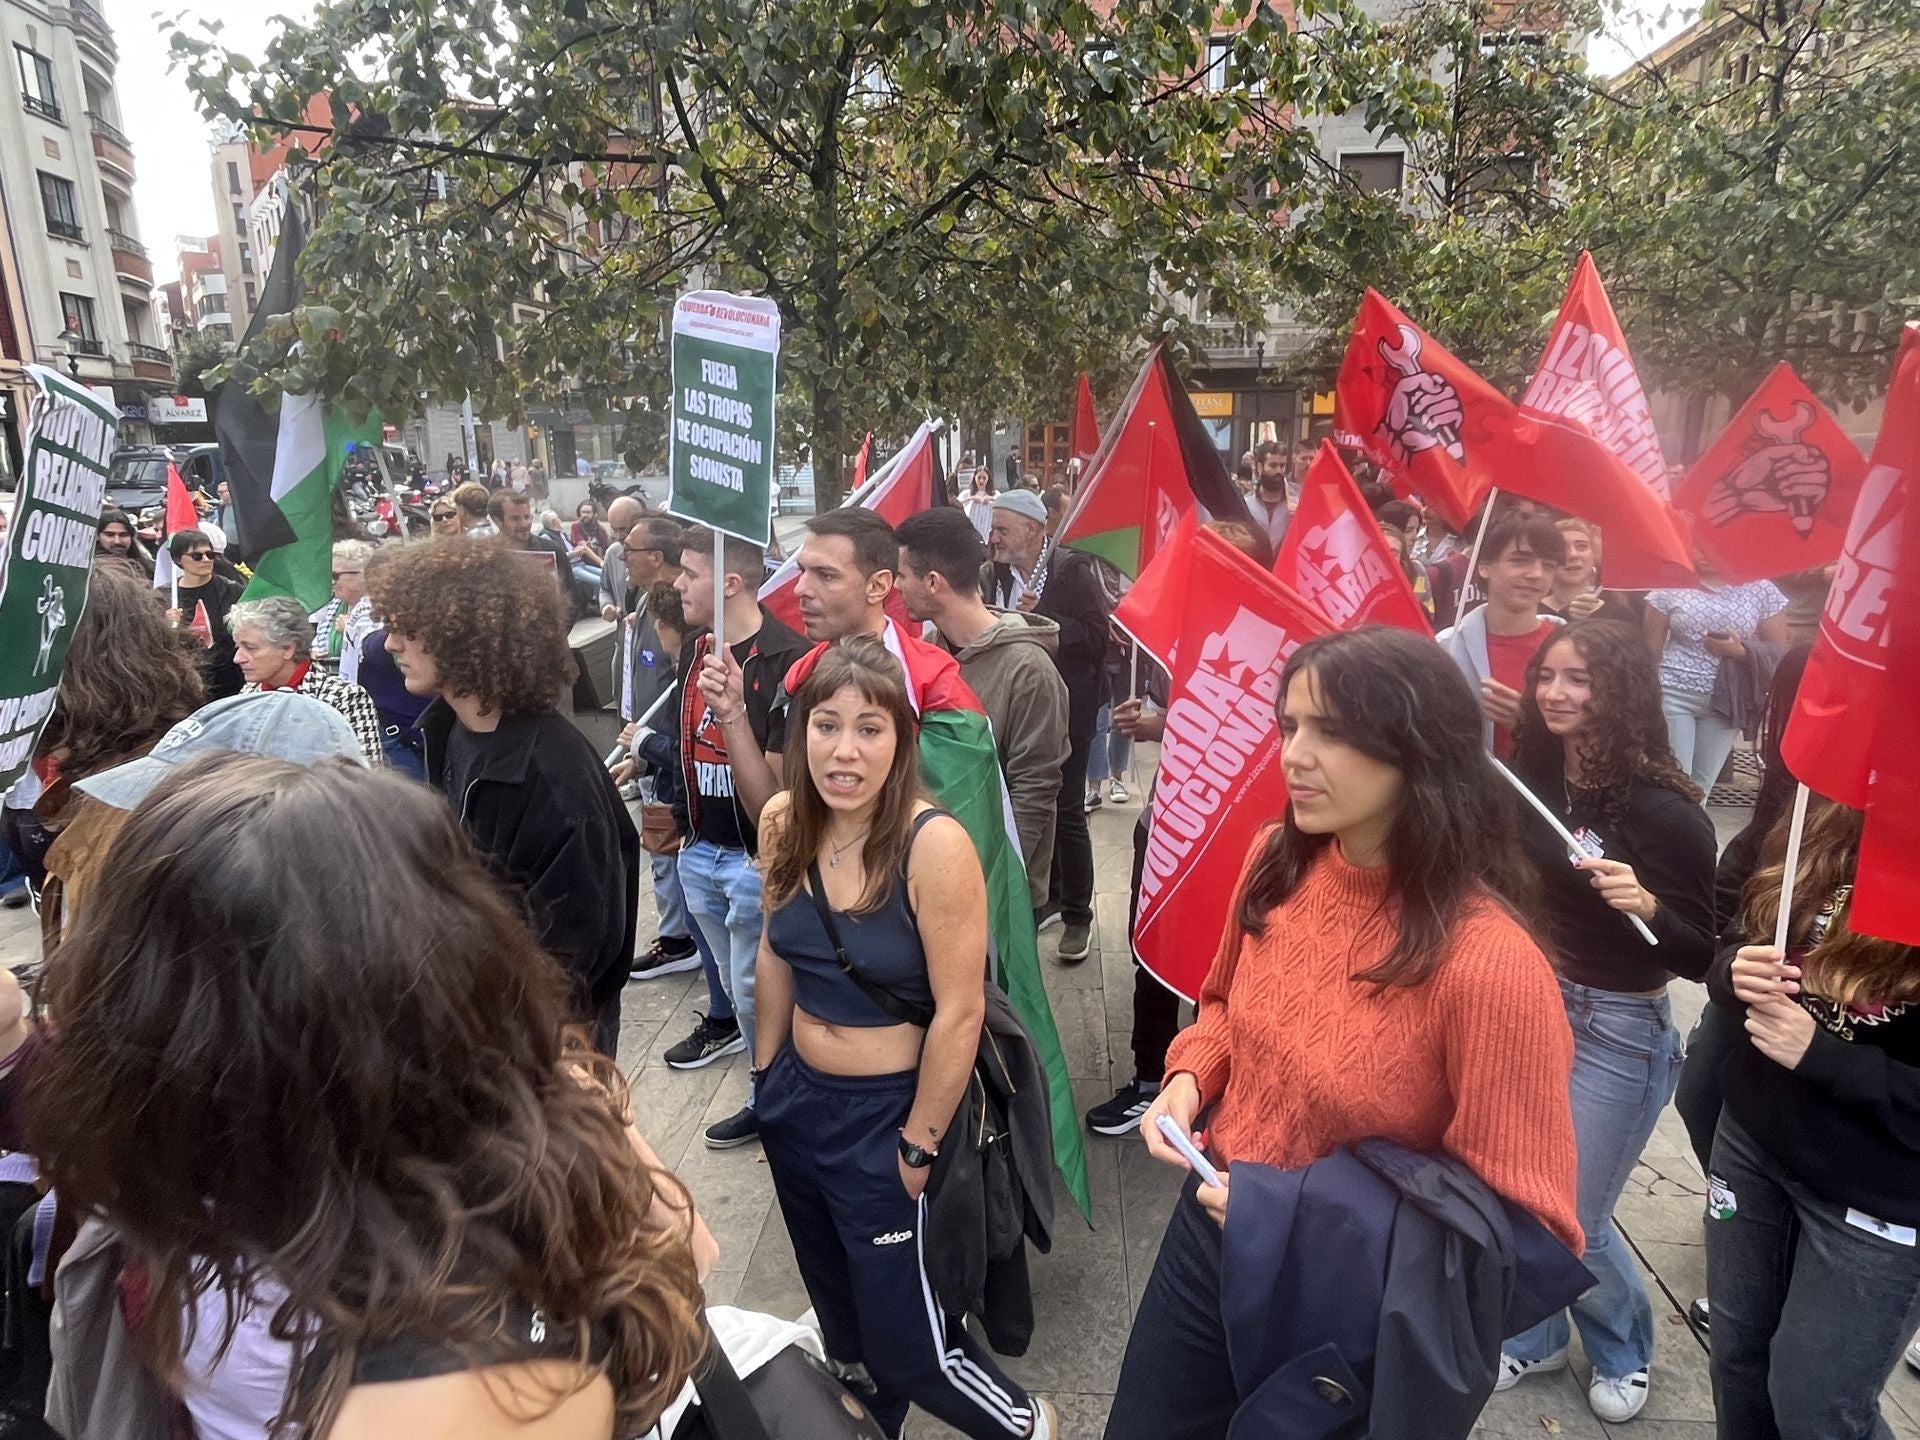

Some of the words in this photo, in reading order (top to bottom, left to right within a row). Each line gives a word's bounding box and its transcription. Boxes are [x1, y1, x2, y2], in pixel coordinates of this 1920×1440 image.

[716, 306, 770, 327] REVOLUCIONARIA
[701, 359, 738, 391] FUERA
[684, 388, 707, 418] LAS
[708, 393, 752, 429] TROPAS
[677, 418, 692, 443] DE
[691, 420, 762, 465] OCUPACIÓN
[689, 453, 744, 493] SIONISTA
[21, 509, 66, 564] CON
[1311, 548, 1393, 628] ARIA
[1824, 552, 1897, 648] RE
[873, 1230, 913, 1246] adidas
